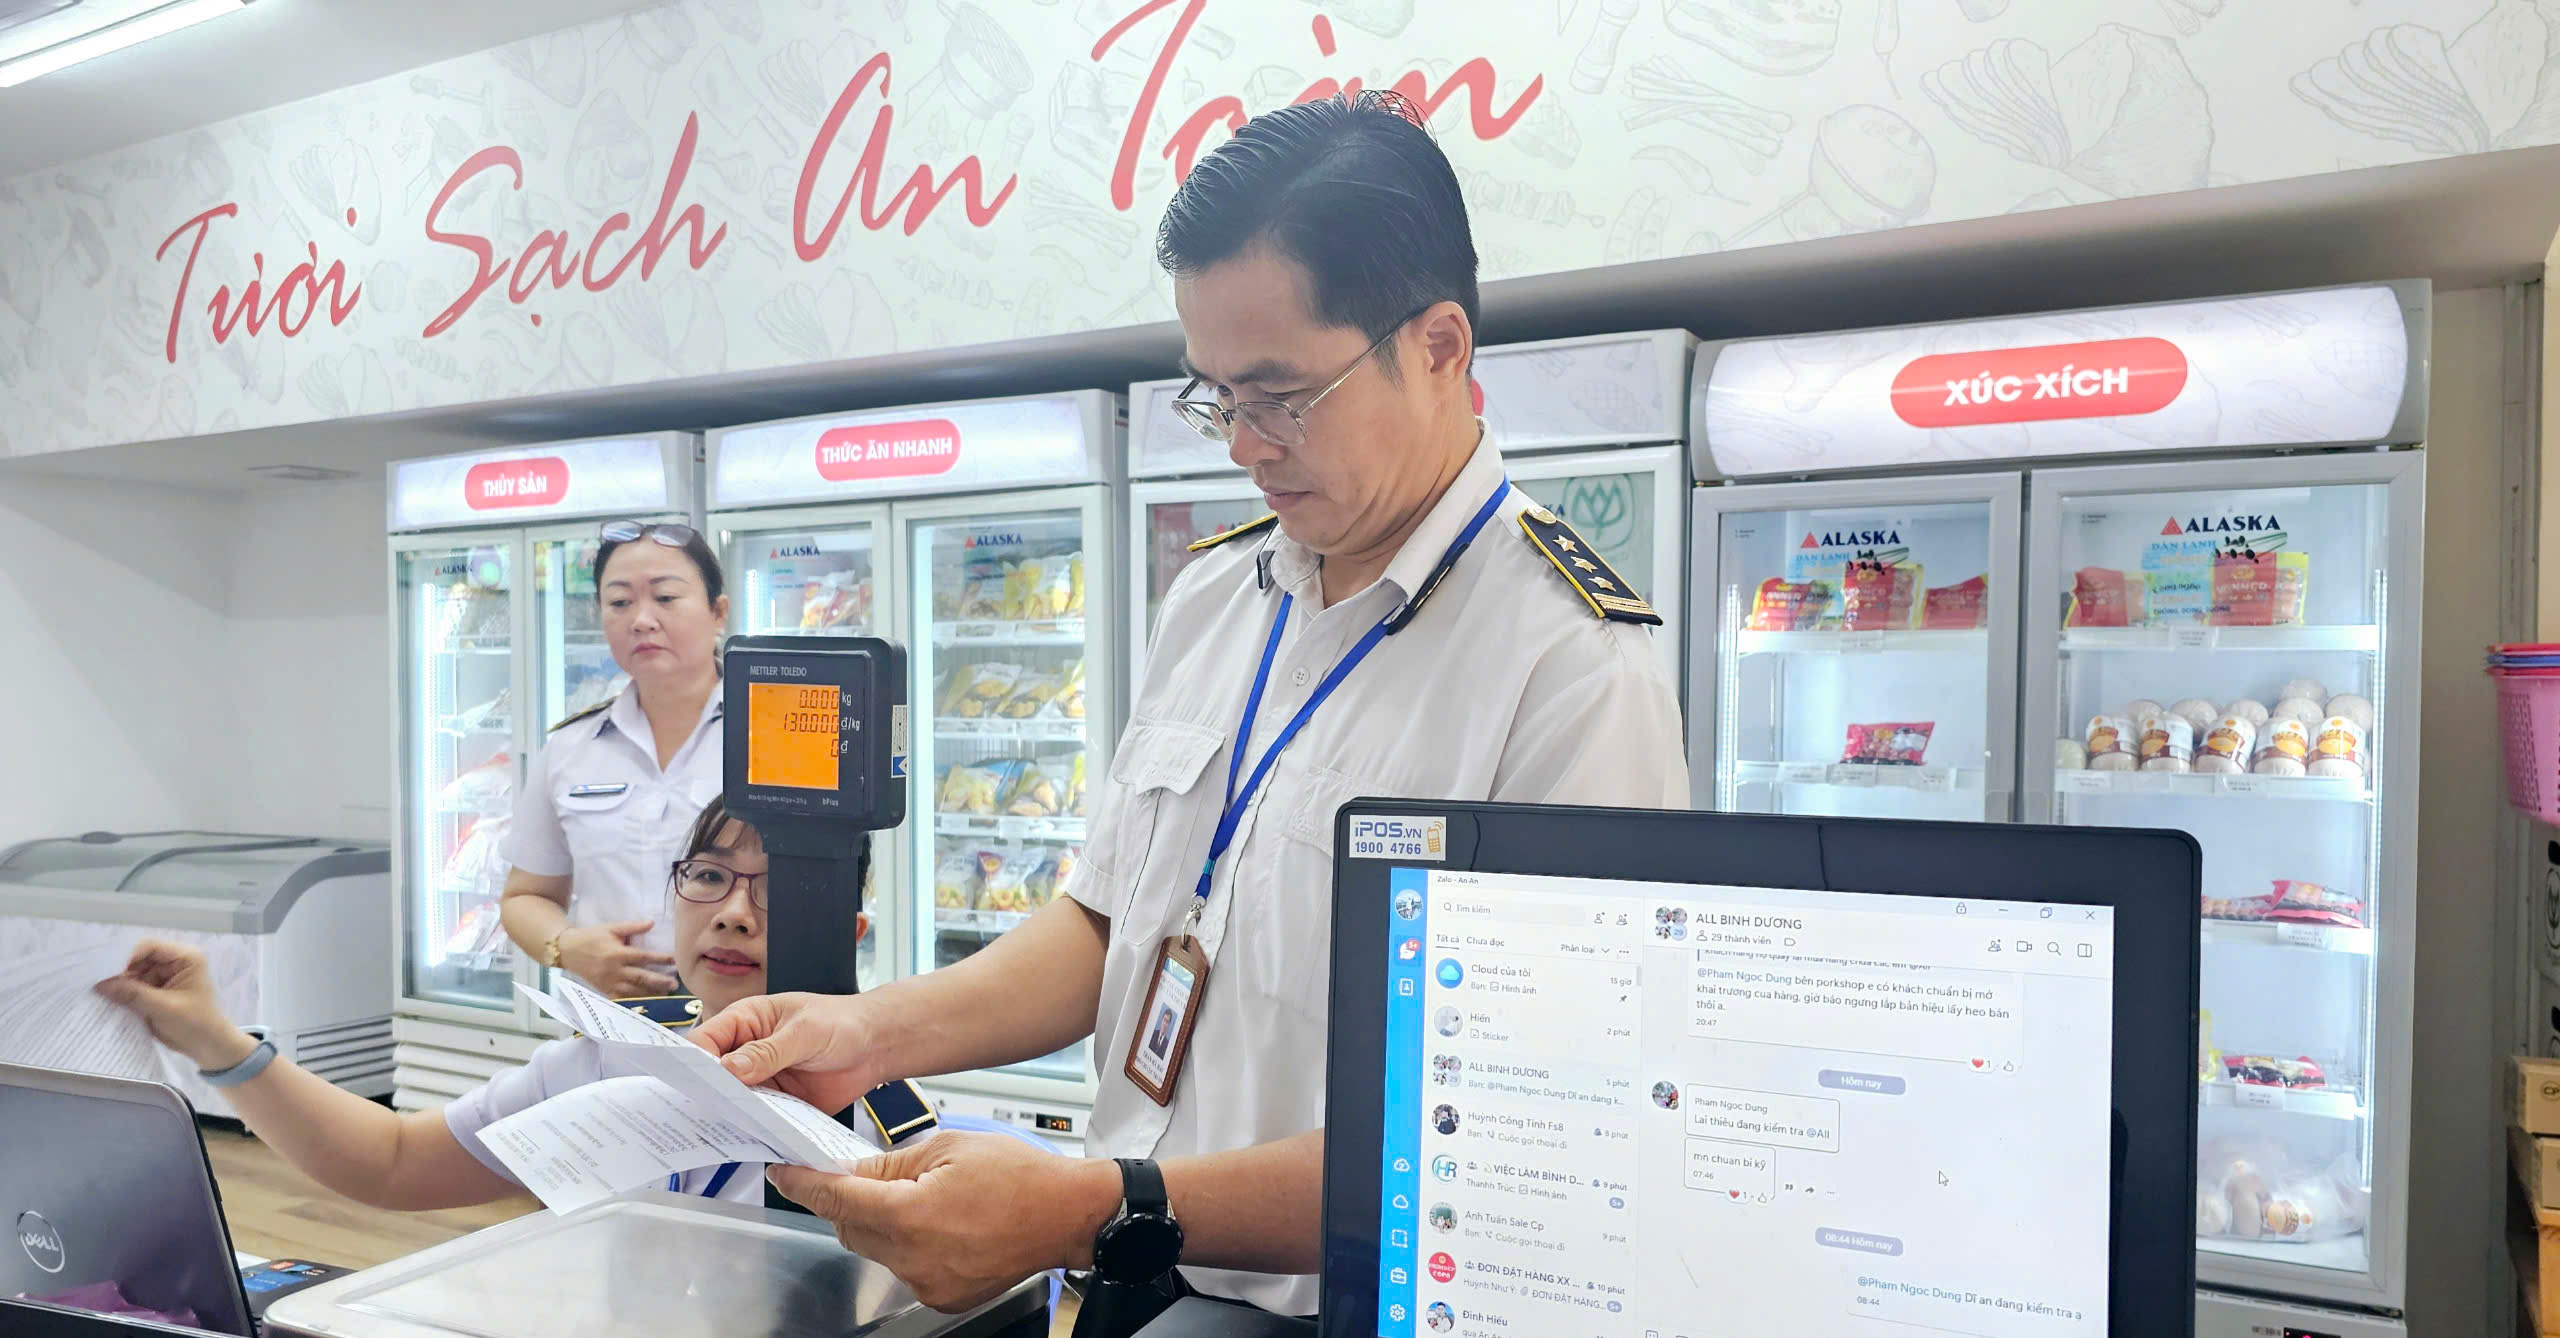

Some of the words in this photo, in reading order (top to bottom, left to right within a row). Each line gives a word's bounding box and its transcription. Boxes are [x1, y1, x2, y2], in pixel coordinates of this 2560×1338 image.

[156, 202, 364, 364] Tươi
[421, 110, 728, 340] Sạch
[793, 52, 1018, 263] An
[1944, 369, 2023, 406] XÚC
[2033, 365, 2129, 399] XÍCH
[822, 441, 862, 464] THỨC
[866, 438, 889, 460] ĂN
[893, 437, 953, 459] NHANH
[483, 473, 516, 497] THỦY
[518, 470, 547, 494] SẢN
[2184, 515, 2281, 532] ALASKA
[976, 533, 1024, 546] ALASKA
[1820, 531, 1901, 546] ALASKA
[779, 545, 821, 557] ALASKA
[750, 665, 778, 676] METTLER
[780, 666, 807, 677] TOLEDO
[841, 692, 852, 706] kg
[1354, 841, 1384, 853] 1900
[1390, 842, 1422, 854] 4766
[1437, 875, 1452, 883] Zalo
[1469, 877, 1479, 885] An
[1696, 913, 1717, 925] ALL
[1754, 916, 1803, 930] DƯƠNG
[1711, 932, 1722, 941] 29
[1724, 933, 1751, 944] thành
[1471, 964, 1498, 975] Cloud
[1766, 974, 1792, 986] Dung
[1816, 978, 1865, 992] porkshop
[1696, 984, 1717, 995] khai
[1965, 1006, 1986, 1017] heo
[1696, 1018, 1717, 1027] 20:47
[1482, 1031, 1509, 1042] Sticker
[1468, 1062, 1484, 1073] ALL
[1865, 1079, 1882, 1090] nay
[1720, 1100, 1743, 1111] Ngoc
[1745, 1103, 1768, 1115] Dung
[1790, 1126, 1804, 1137] tra
[1806, 1127, 1830, 1139] @All
[1694, 1152, 1709, 1162] mn
[1465, 1210, 1484, 1222] Anh
[1510, 1216, 1529, 1228] Sale
[25, 1232, 60, 1252] DELL
[1933, 1287, 1962, 1304] Dung
